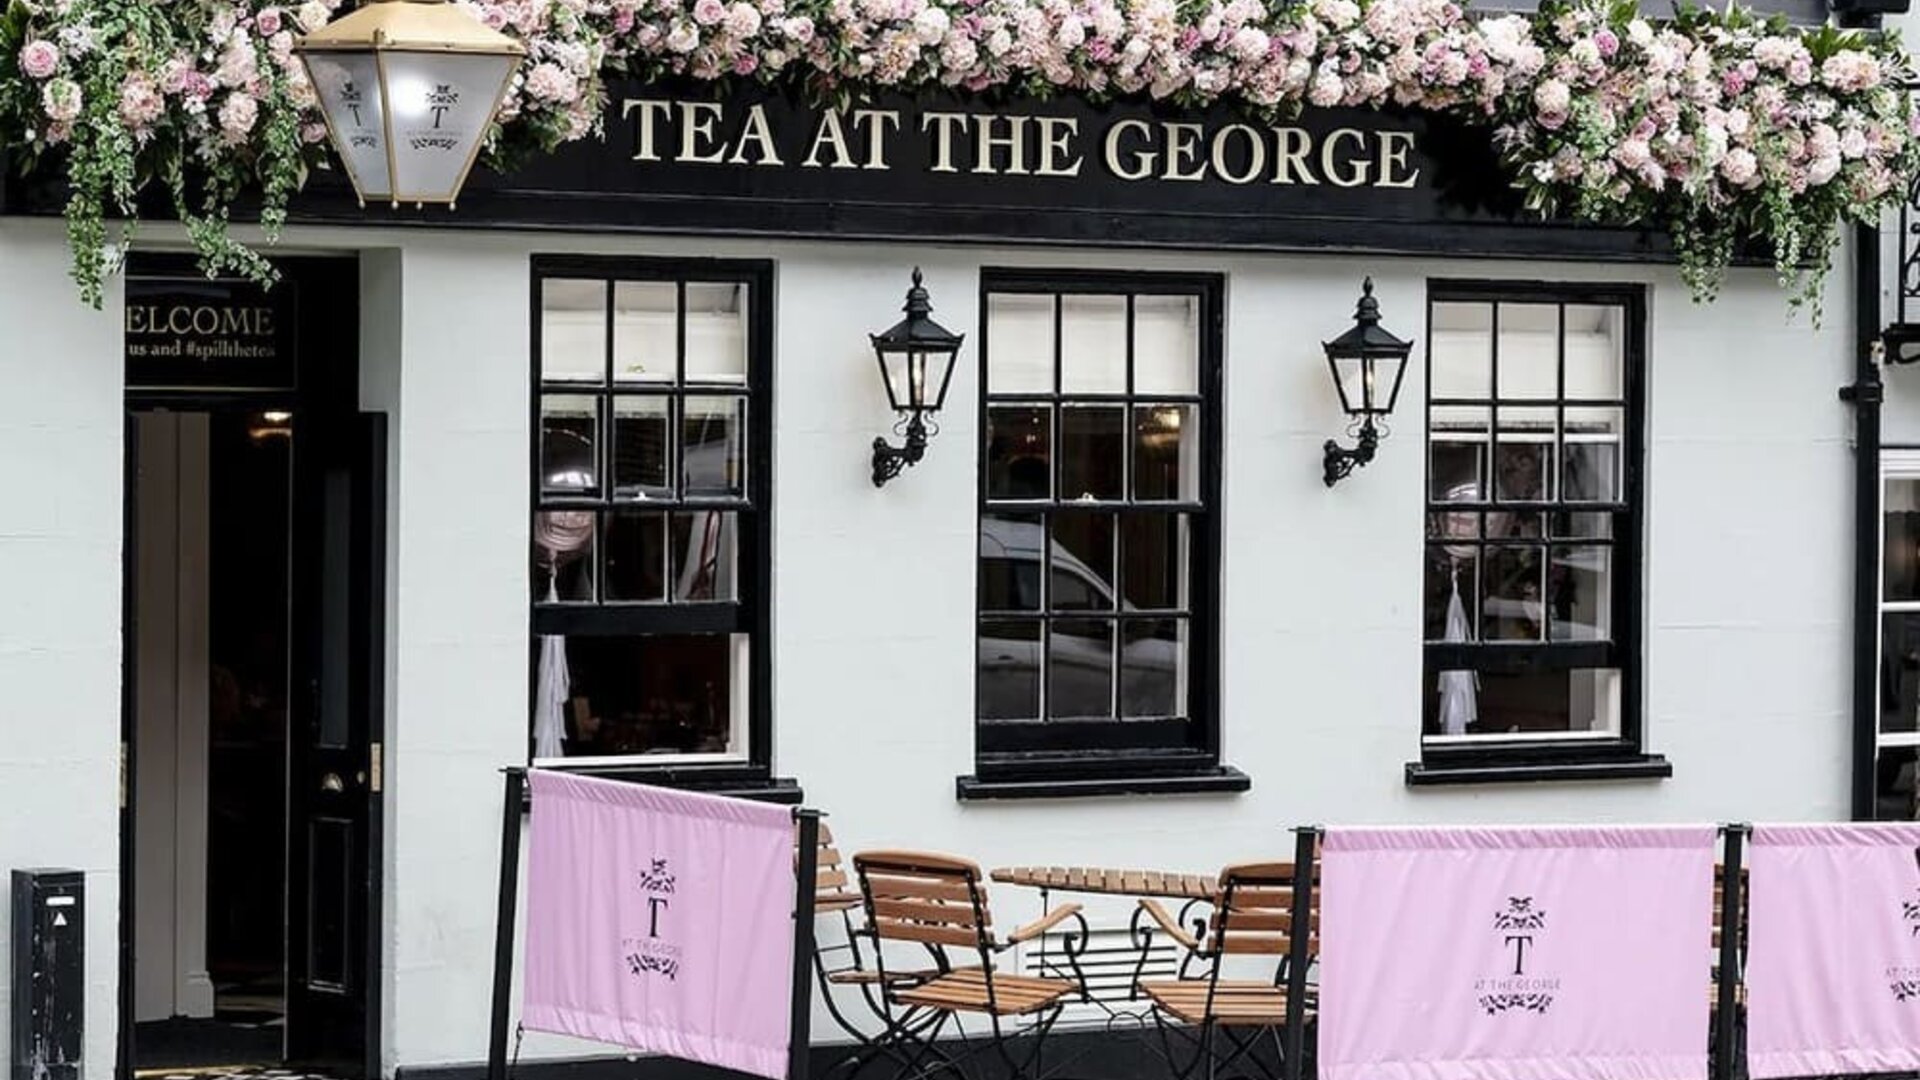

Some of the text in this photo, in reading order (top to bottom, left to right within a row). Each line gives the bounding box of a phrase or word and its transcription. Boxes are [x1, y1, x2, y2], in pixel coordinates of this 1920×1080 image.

[430, 106, 449, 129] T
[622, 98, 1420, 189] TEA AT THE GEORGE
[125, 305, 276, 335] ELCOME
[128, 344, 147, 356] us
[150, 338, 181, 357] and
[647, 896, 669, 938] T
[1504, 935, 1533, 975] T
